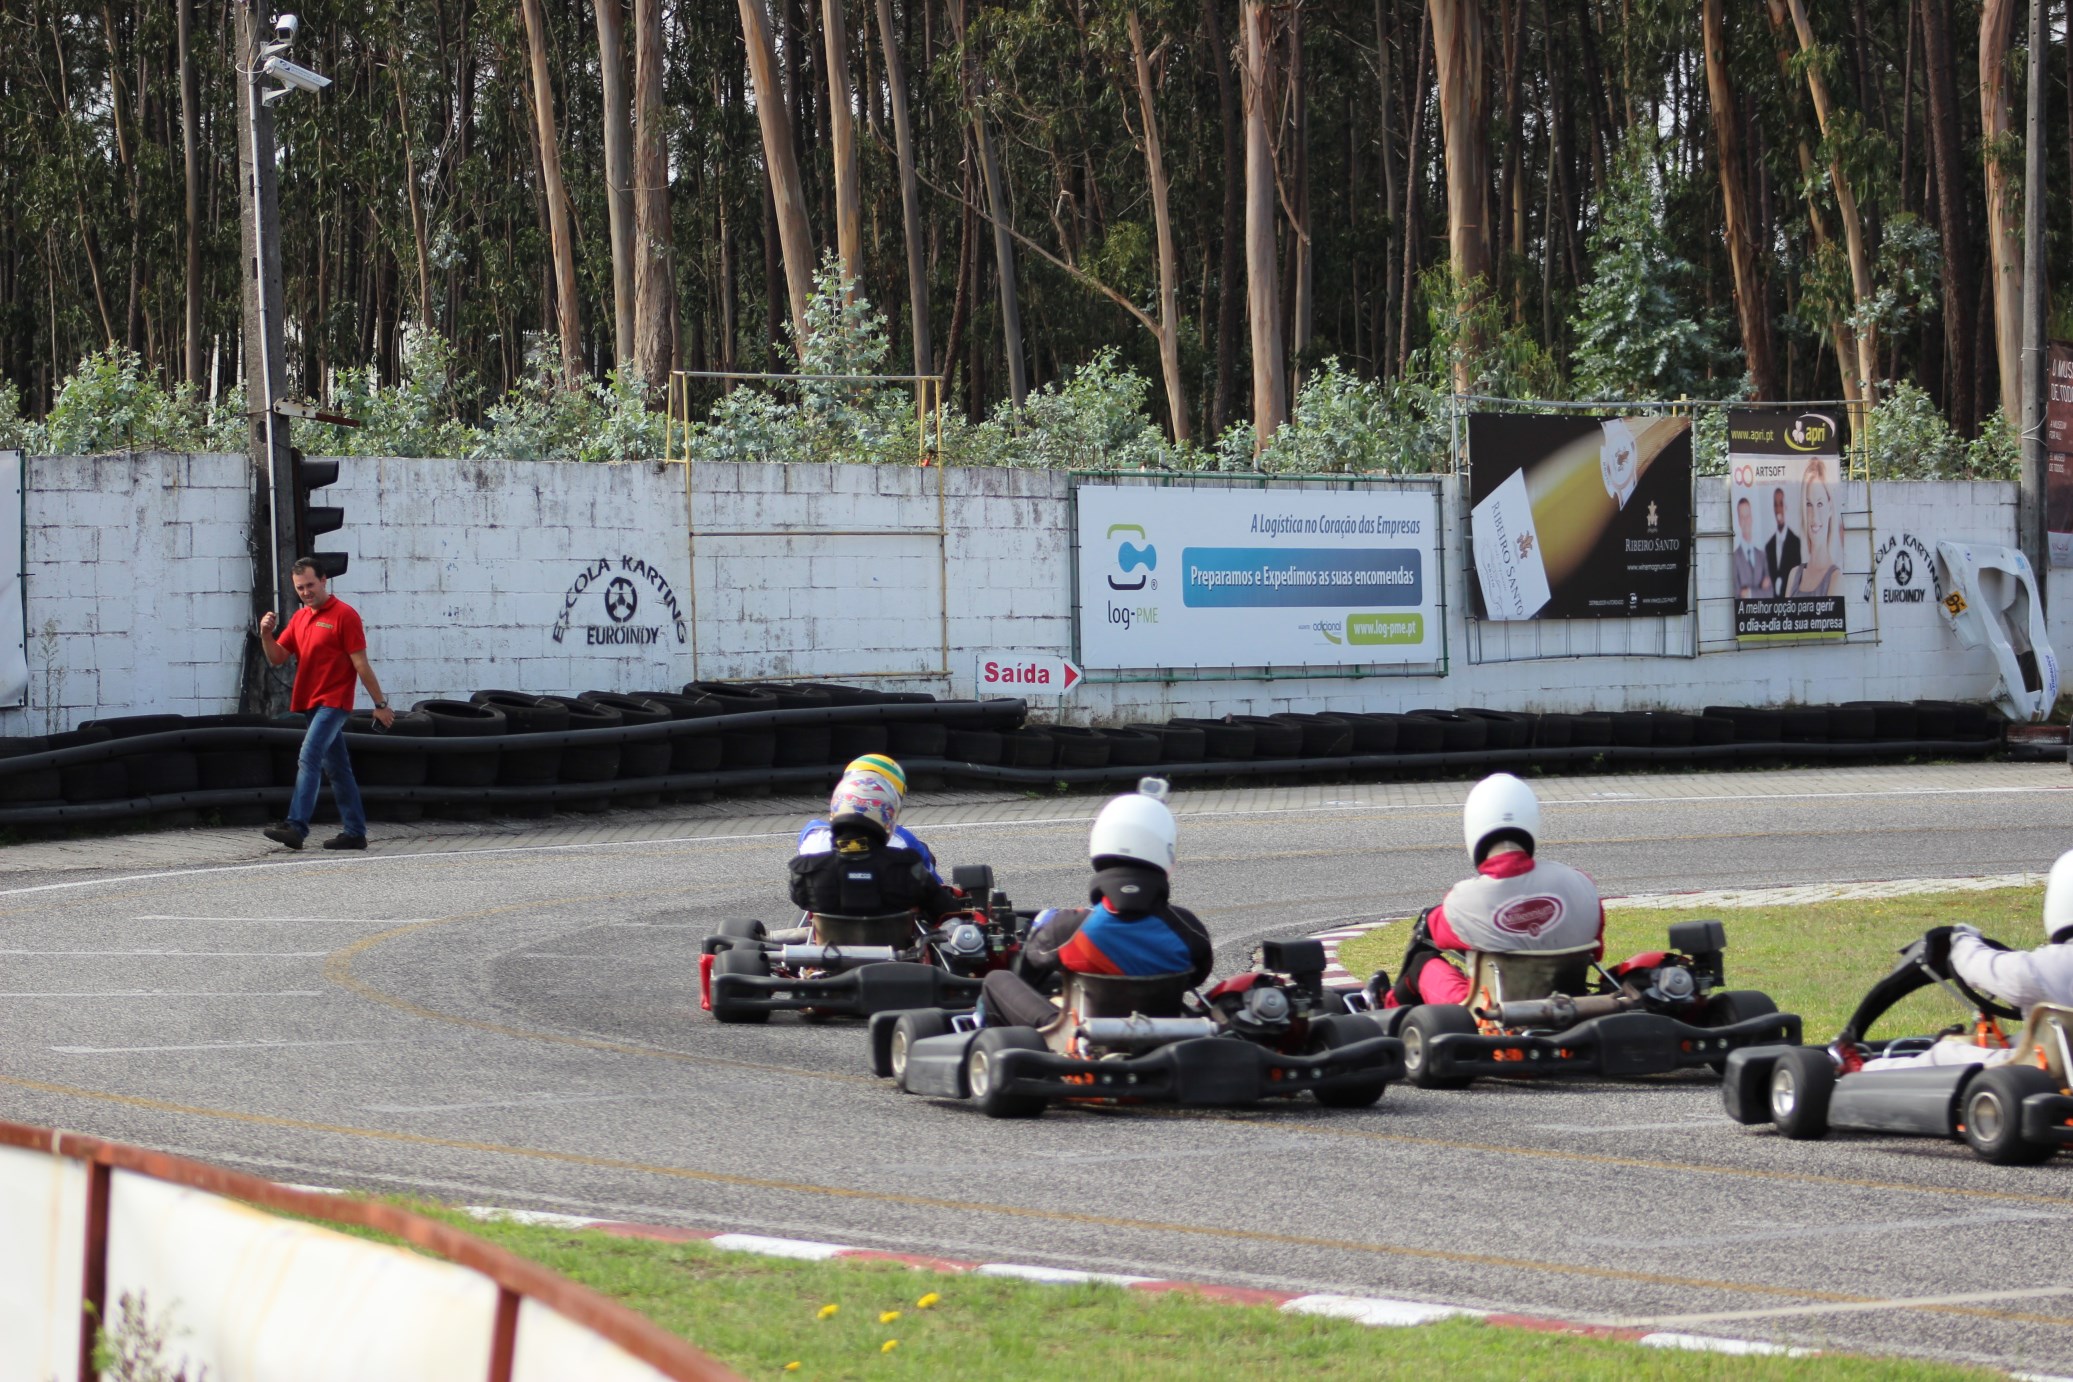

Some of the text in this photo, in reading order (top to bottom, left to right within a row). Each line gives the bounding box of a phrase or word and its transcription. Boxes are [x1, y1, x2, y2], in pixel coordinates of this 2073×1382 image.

[2050, 383, 2060, 401] DE
[1731, 429, 1774, 443] www.apri.pt
[1806, 423, 1826, 446] apri
[1755, 466, 1786, 477] ARTSOFT
[1251, 514, 1421, 539] A Logística no Coração das Empresas
[1654, 538, 1680, 552] SANTO
[1491, 501, 1511, 564] RIBEIRO
[1506, 566, 1524, 616] SANTO
[1902, 533, 1943, 602] KARTING
[1191, 565, 1414, 591] Preparamos e Expedimos as suas encomendas
[552, 554, 687, 645] ESCOLA KARTING
[1883, 588, 1925, 603] EUROINDY
[1107, 600, 1159, 630] log-PME
[1738, 599, 1835, 616] A melhor opção para gerir
[1353, 619, 1416, 638] www.log-pme.pt
[1739, 617, 1843, 632] o dia-a-dia da sua empresa
[587, 625, 659, 645] EUROINDY
[984, 661, 1050, 684] Saída
